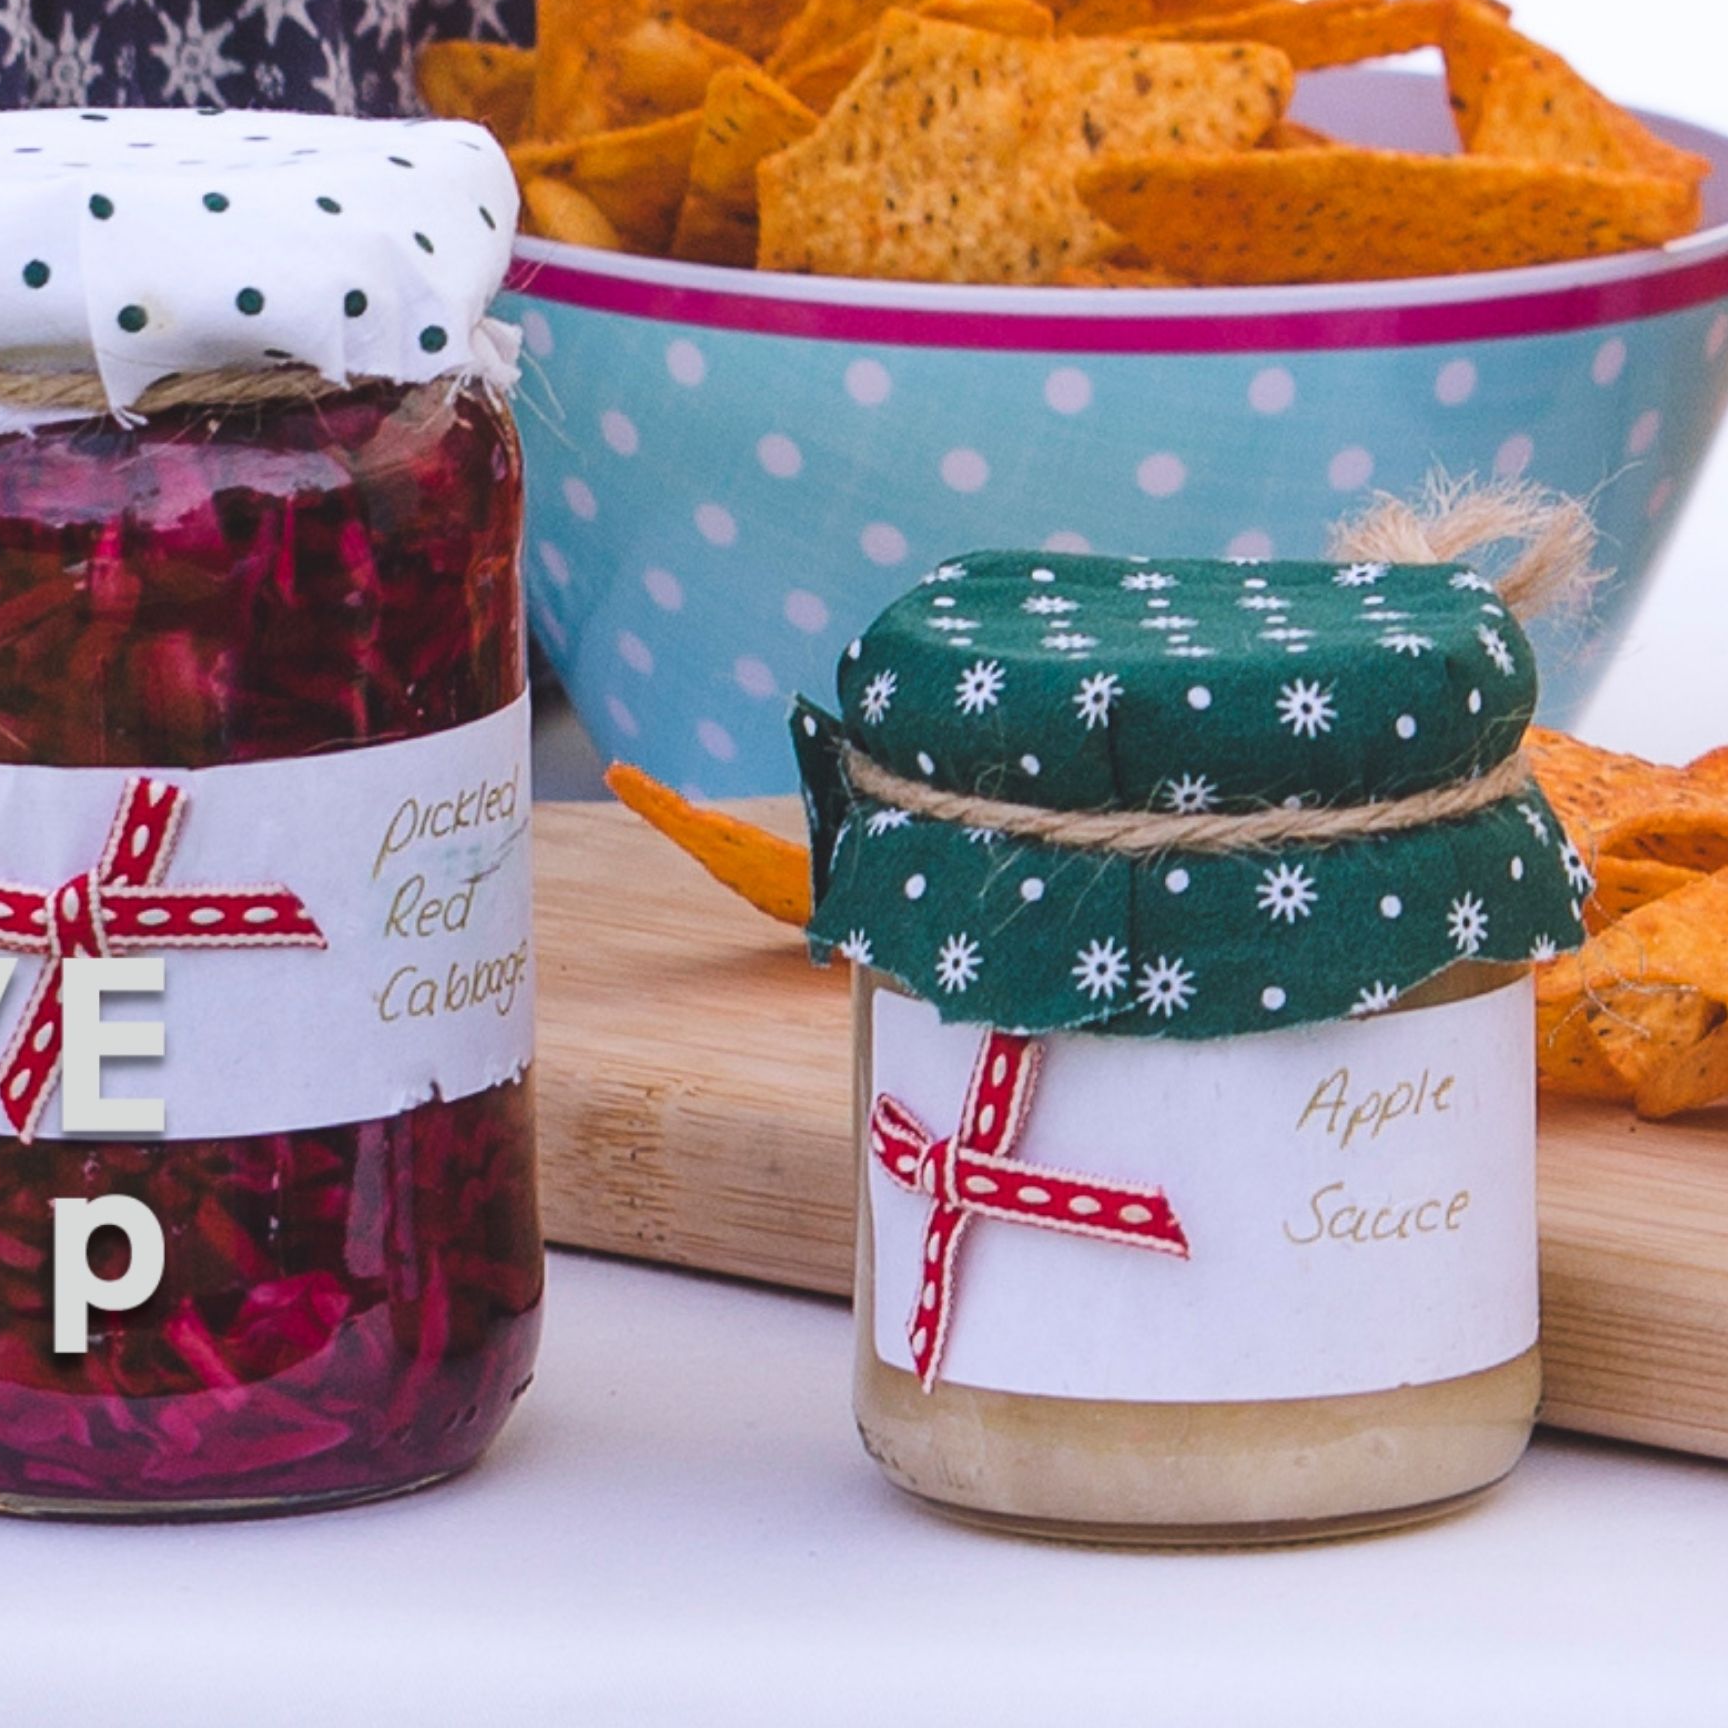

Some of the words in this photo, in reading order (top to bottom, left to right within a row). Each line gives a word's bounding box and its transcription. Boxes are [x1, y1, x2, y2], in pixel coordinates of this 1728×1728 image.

[383, 874, 475, 938] Red
[1295, 1066, 1456, 1150] Apple
[1282, 1179, 1470, 1245] Sauce
